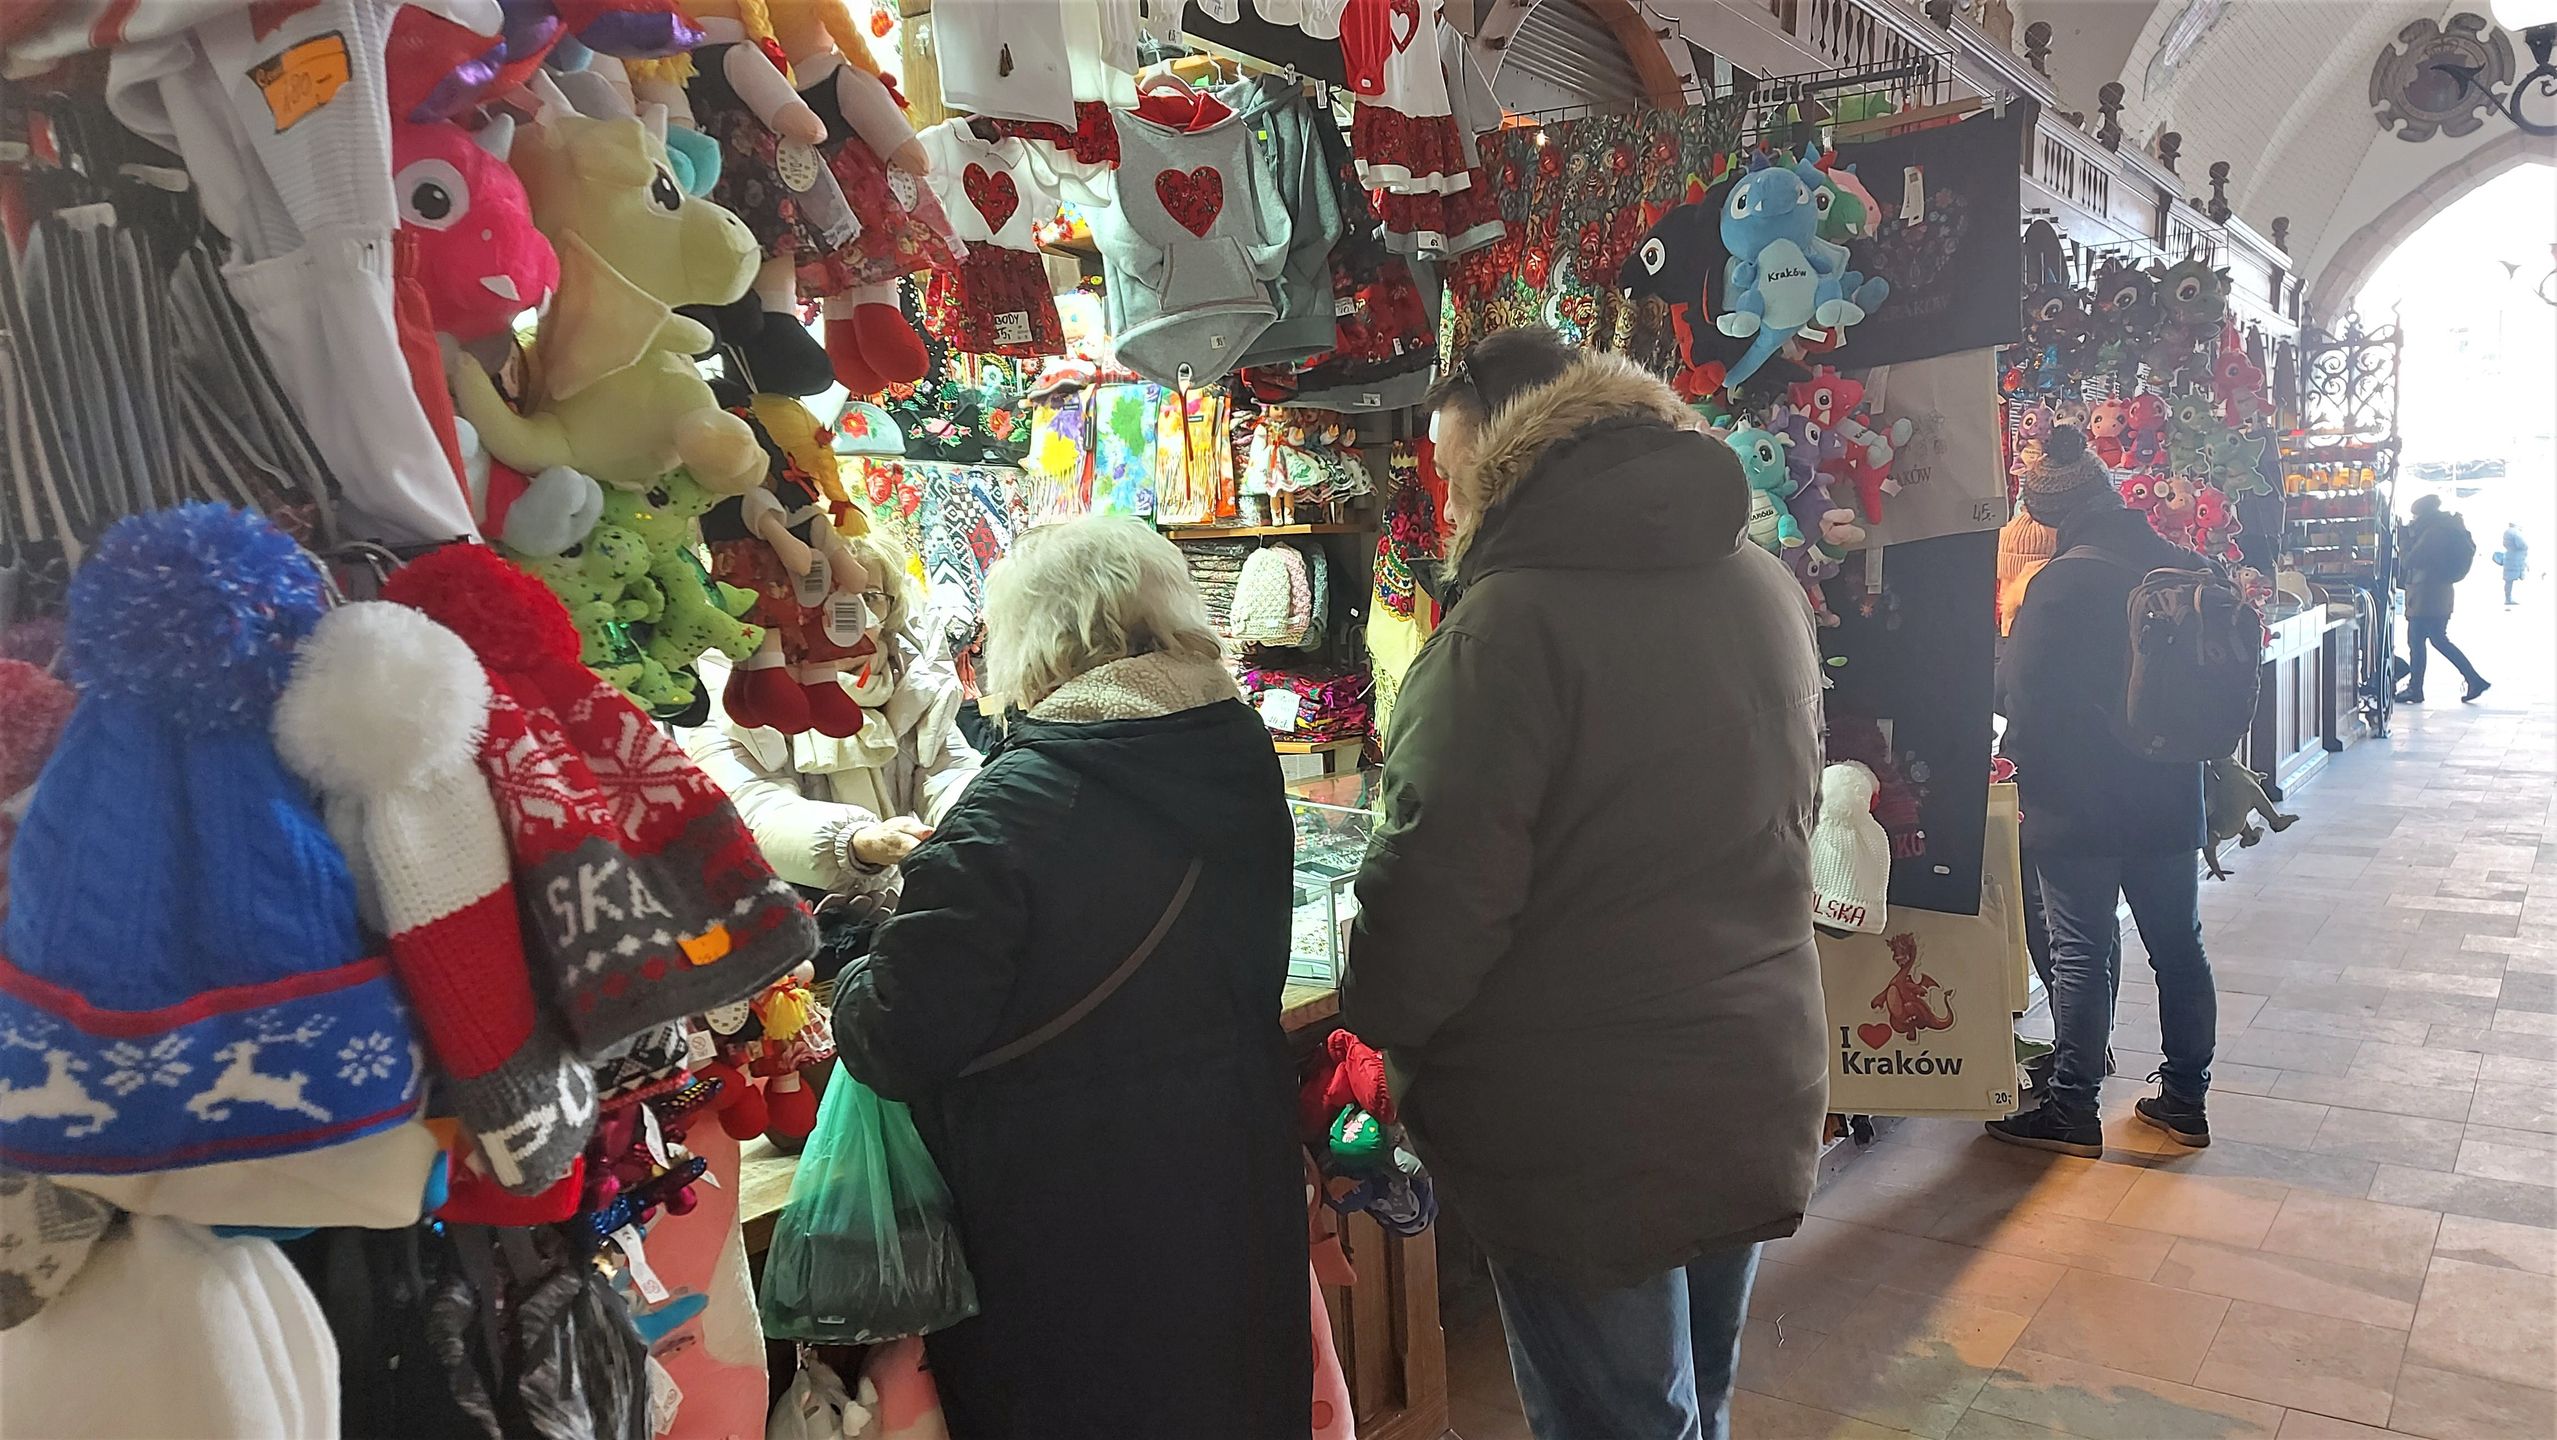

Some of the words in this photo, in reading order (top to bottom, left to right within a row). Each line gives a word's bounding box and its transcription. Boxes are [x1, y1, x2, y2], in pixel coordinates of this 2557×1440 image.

[1767, 266, 1807, 282] Kraków
[995, 313, 1019, 325] BODY
[546, 857, 674, 948] SKA
[1812, 891, 1866, 927] LSKA
[1840, 1026, 1851, 1048] I
[1841, 1049, 1963, 1076] Kraków
[477, 1057, 595, 1188] PO
